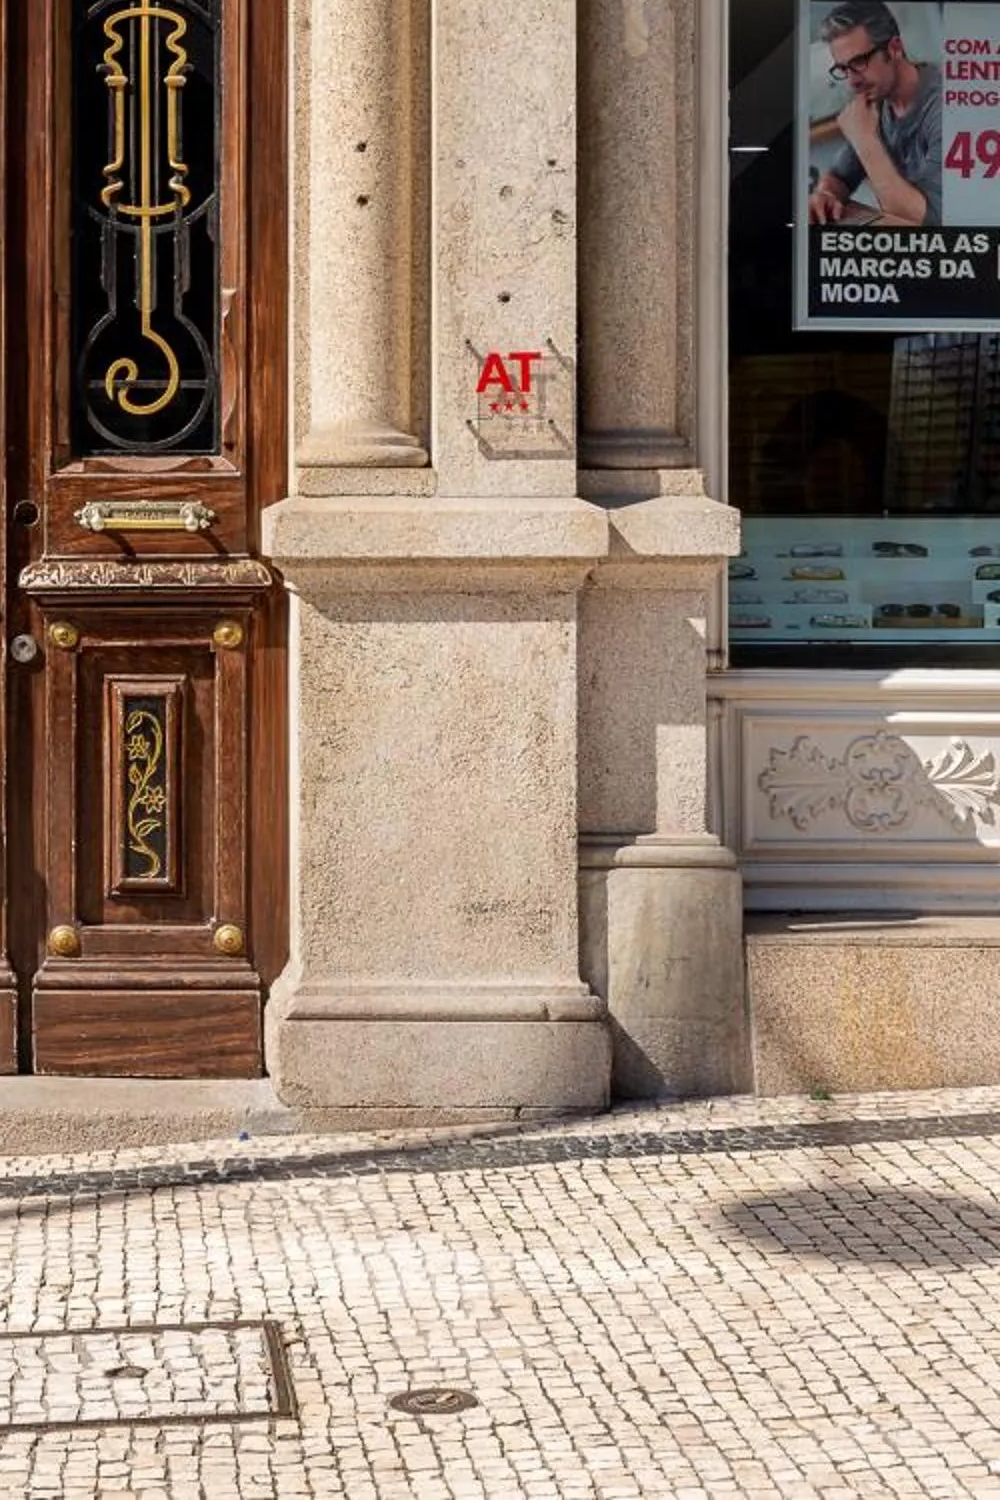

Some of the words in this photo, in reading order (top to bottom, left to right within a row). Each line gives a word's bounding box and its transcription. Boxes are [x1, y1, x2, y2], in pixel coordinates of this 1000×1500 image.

[944, 39, 991, 55] COM
[945, 60, 1000, 81] LENT
[945, 91, 1000, 106] PROG
[944, 130, 1000, 179] 49
[820, 233, 947, 253] ESCOLHA
[954, 234, 990, 253] AS
[820, 257, 931, 278] MARCAS
[939, 259, 976, 278] DA
[821, 283, 900, 303] MODA
[476, 351, 541, 392] AT
